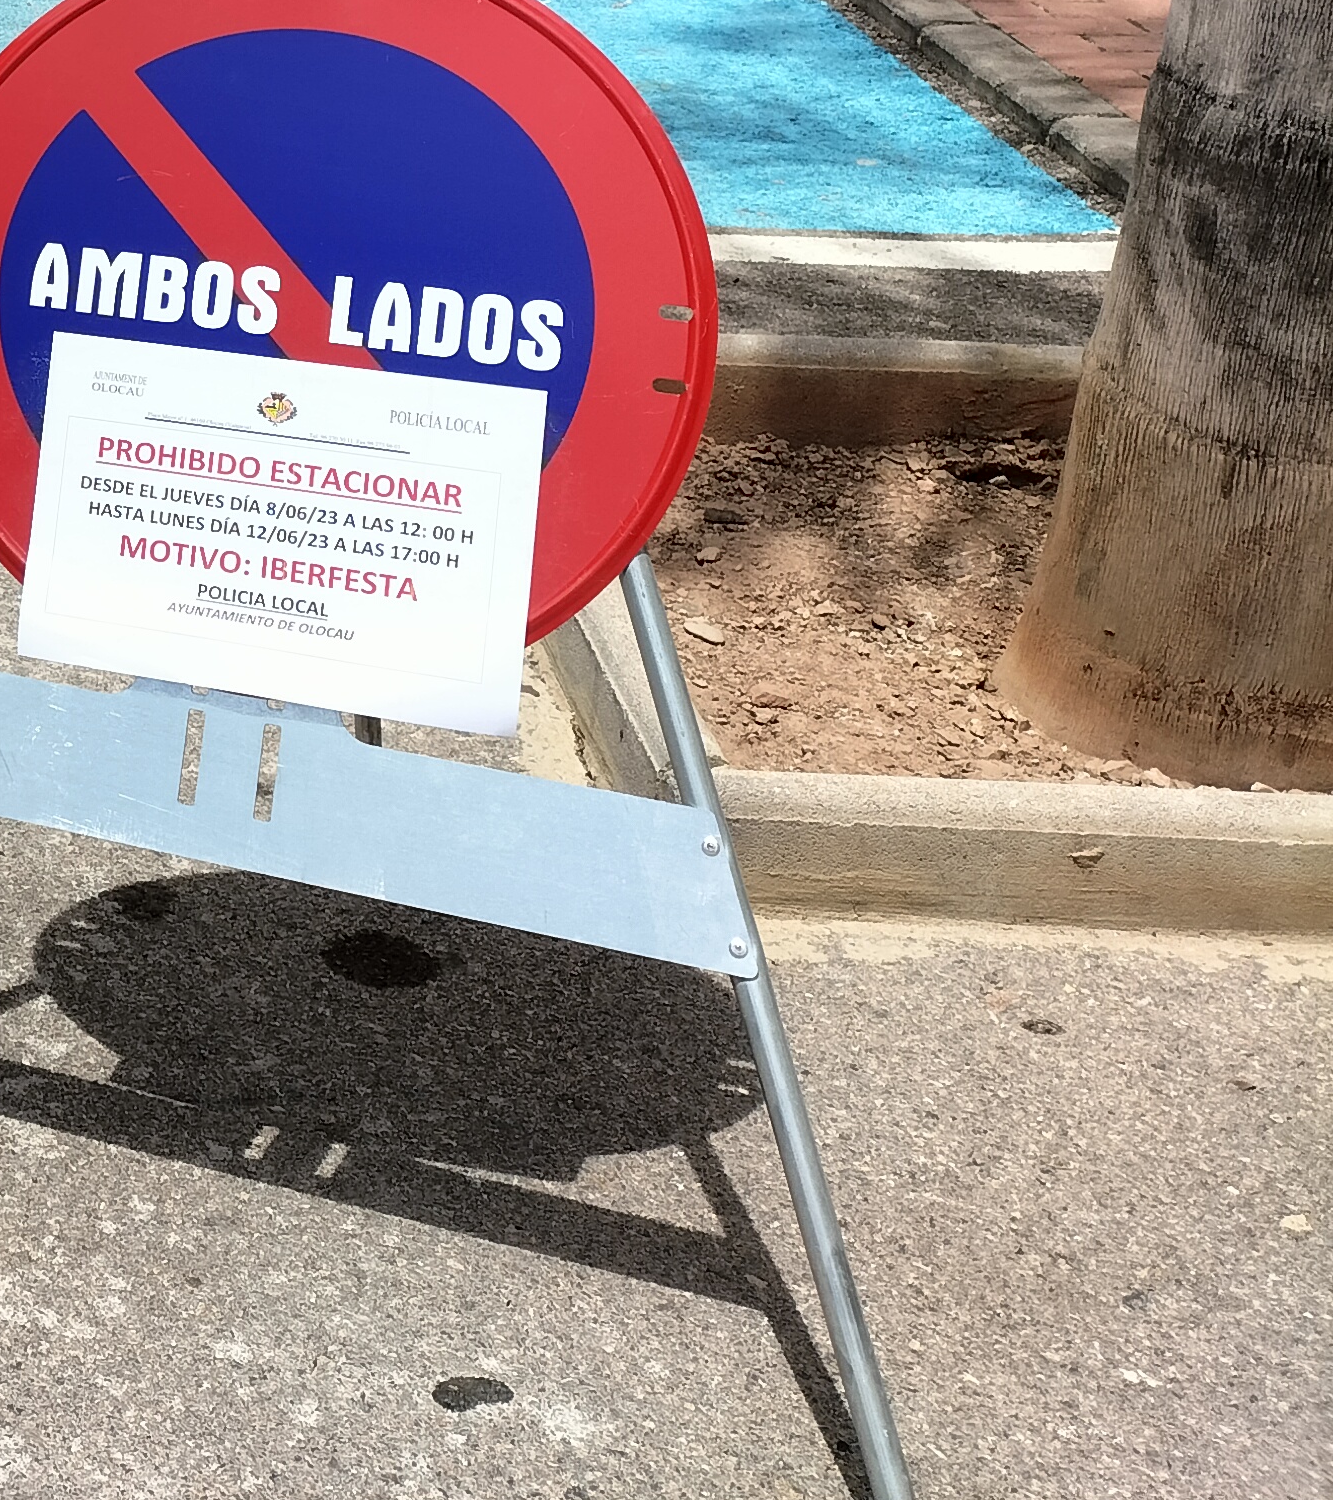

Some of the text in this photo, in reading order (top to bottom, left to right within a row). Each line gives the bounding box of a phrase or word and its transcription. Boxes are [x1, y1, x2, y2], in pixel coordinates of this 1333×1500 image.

[29, 241, 565, 373] AMBOS LADOS
[91, 382, 145, 397] OLOCAU
[137, 375, 148, 386] DE
[389, 409, 491, 436] POLICÍA LOCAL
[98, 436, 463, 508] PROHIBIDO ESTACIONAR
[80, 475, 474, 544] DESDE EL JUEVES DÍA 8/06/23 A LAS 12: 00 H
[88, 501, 459, 569] HASTA LUNES DÍA 12/06/23 A LAS 17:00 H
[119, 534, 418, 602] MOTIVO: IBERFESTA
[167, 602, 355, 641] AYUNTAMIENTO DE OLOCAU
[197, 583, 329, 618] POLICIA LOCAL
